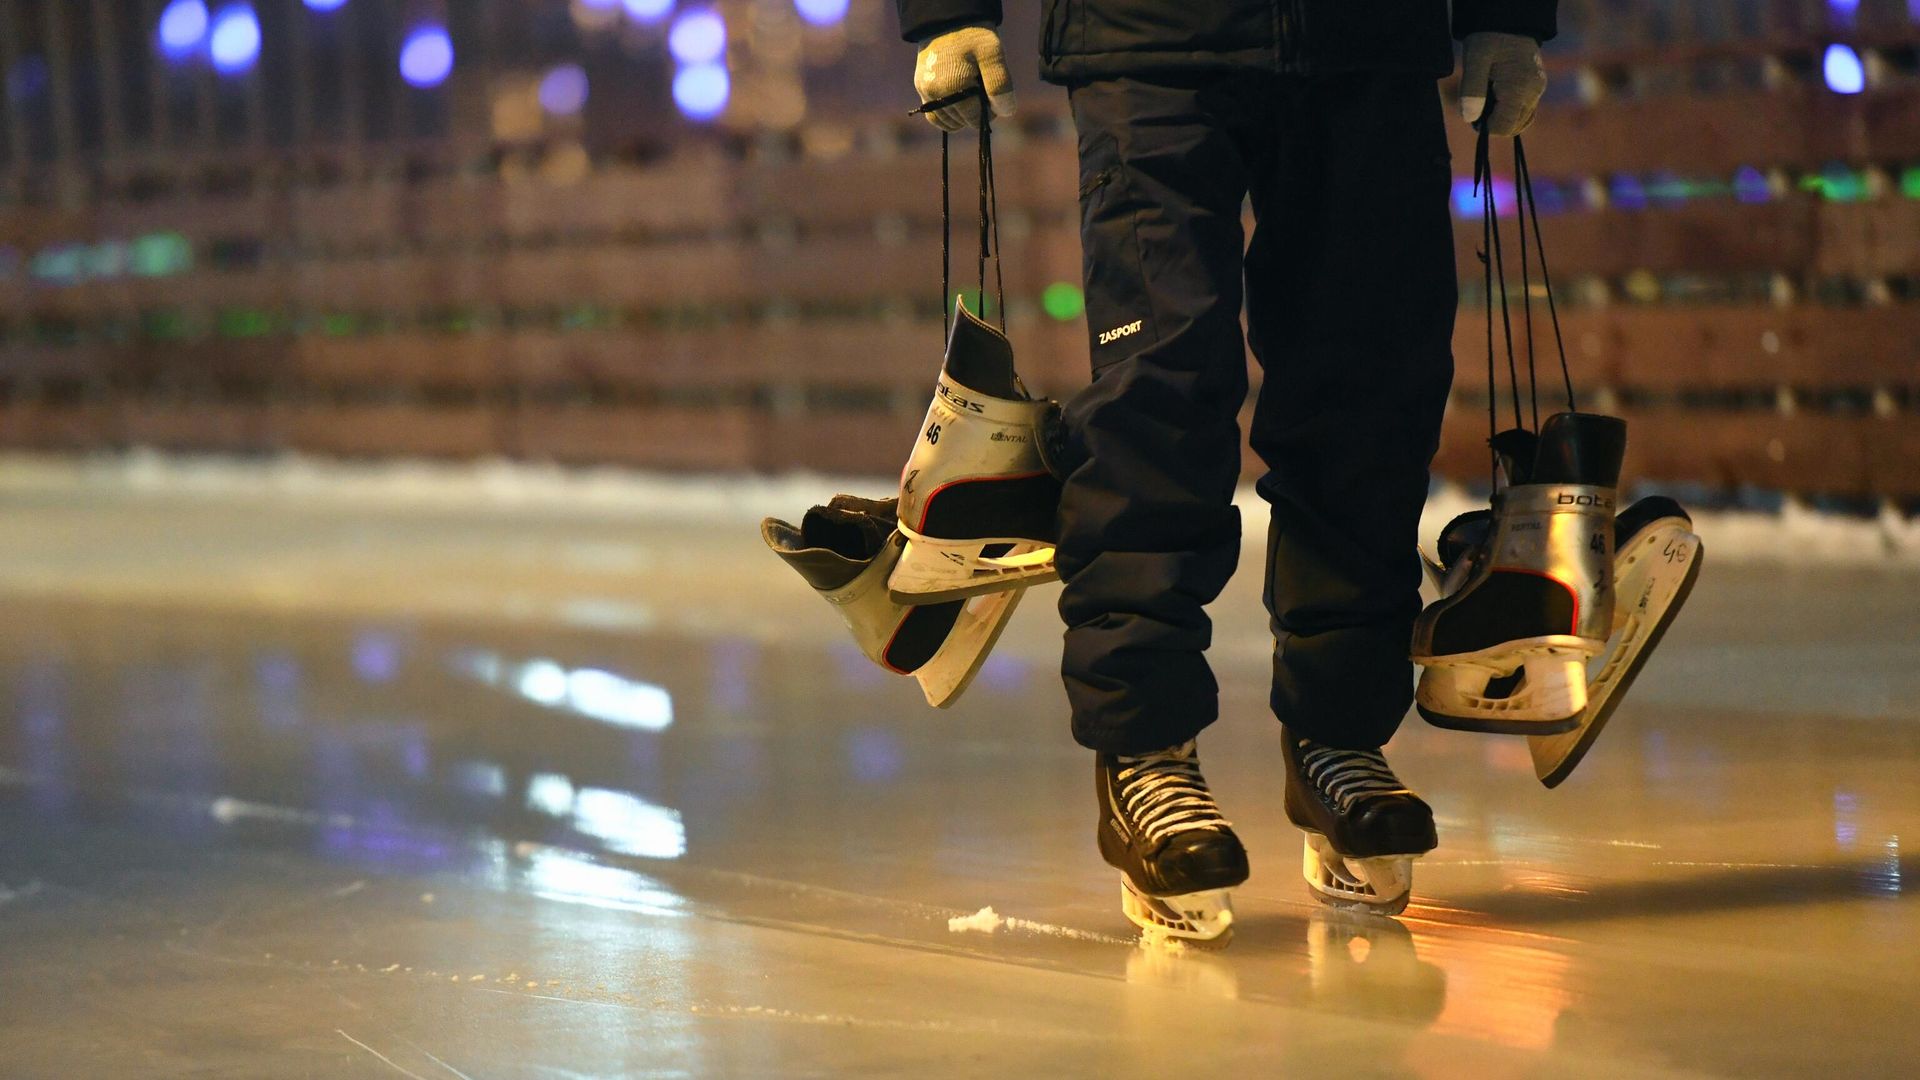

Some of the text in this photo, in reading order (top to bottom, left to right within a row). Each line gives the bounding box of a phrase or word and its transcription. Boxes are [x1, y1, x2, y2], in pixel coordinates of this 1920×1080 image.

[1098, 320, 1142, 345] ZASPORT
[926, 422, 942, 446] 46
[1663, 539, 1687, 564] 46
